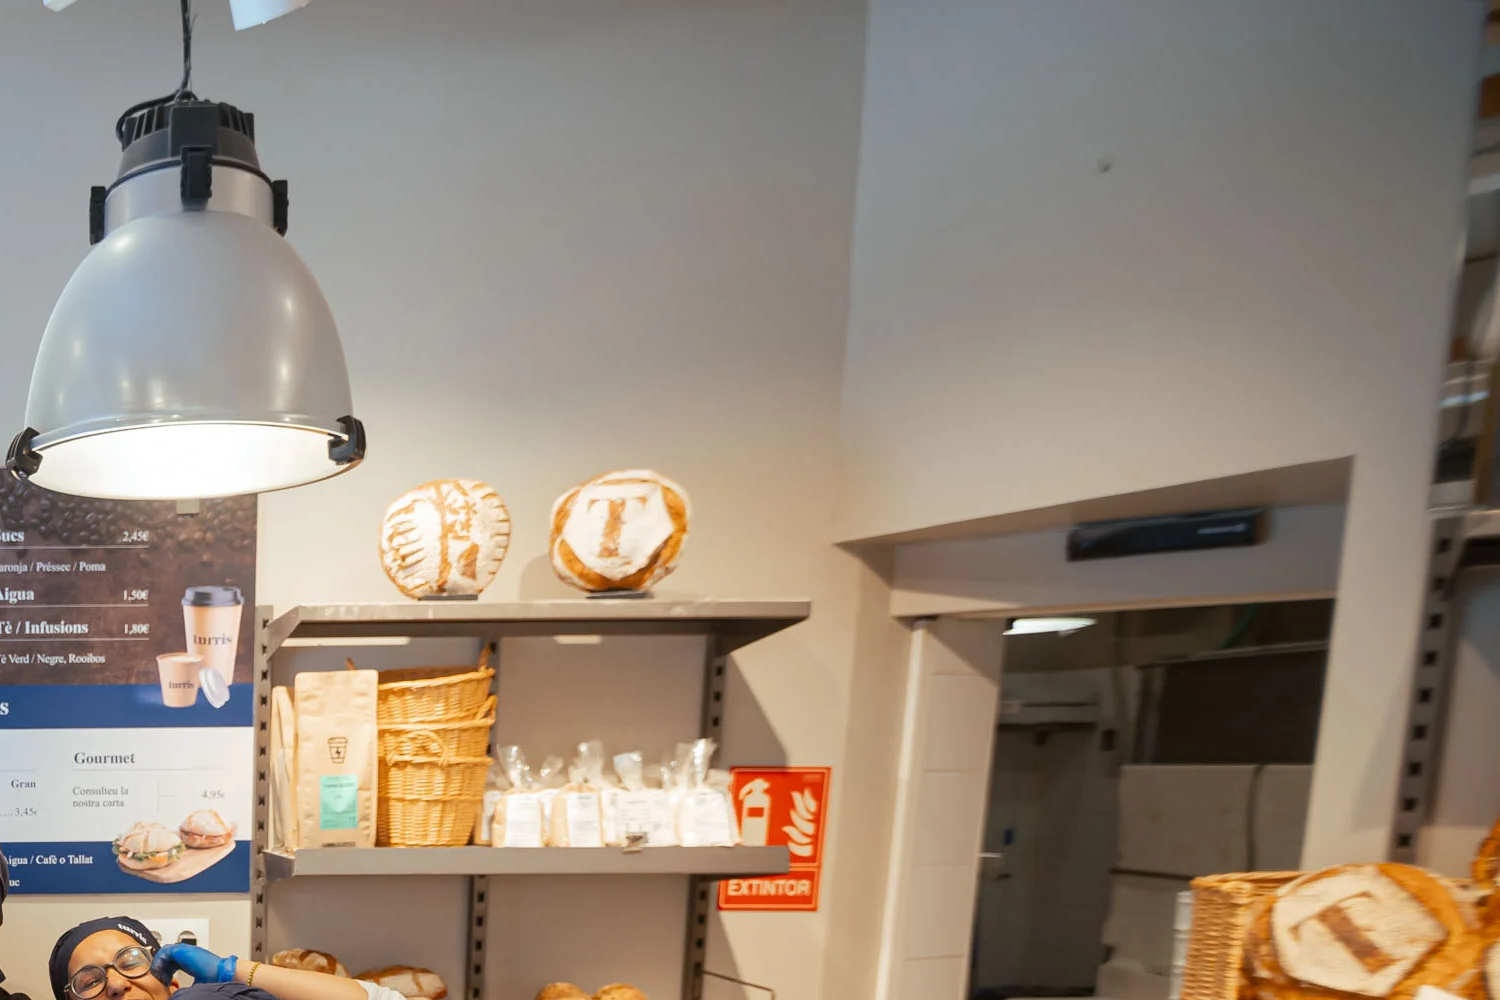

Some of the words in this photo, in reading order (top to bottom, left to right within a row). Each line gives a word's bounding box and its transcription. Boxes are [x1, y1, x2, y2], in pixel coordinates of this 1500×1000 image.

[122, 530, 149, 543] 2,45€
[36, 561, 71, 572] Préssec
[79, 561, 107, 572] Poma
[123, 589, 149, 601] 1,50€
[25, 620, 89, 635] Infusions
[124, 623, 150, 635] 1,80€
[193, 633, 232, 645] turris
[9, 653, 30, 664] Verd
[37, 653, 67, 666] Negre,
[69, 653, 106, 664] Rooibos
[169, 680, 195, 689] turris
[74, 752, 135, 764] Gourmet
[11, 779, 36, 789] Gran
[72, 786, 118, 796] Consulteu
[120, 786, 129, 796] la
[72, 799, 100, 808] nostra
[102, 799, 125, 808] carta
[35, 854, 58, 865] Cafè
[59, 857, 66, 865] o
[67, 854, 93, 865] Tallat
[9, 879, 20, 887] uc
[727, 879, 811, 896] EXTINTOR
[117, 923, 148, 946] turris
